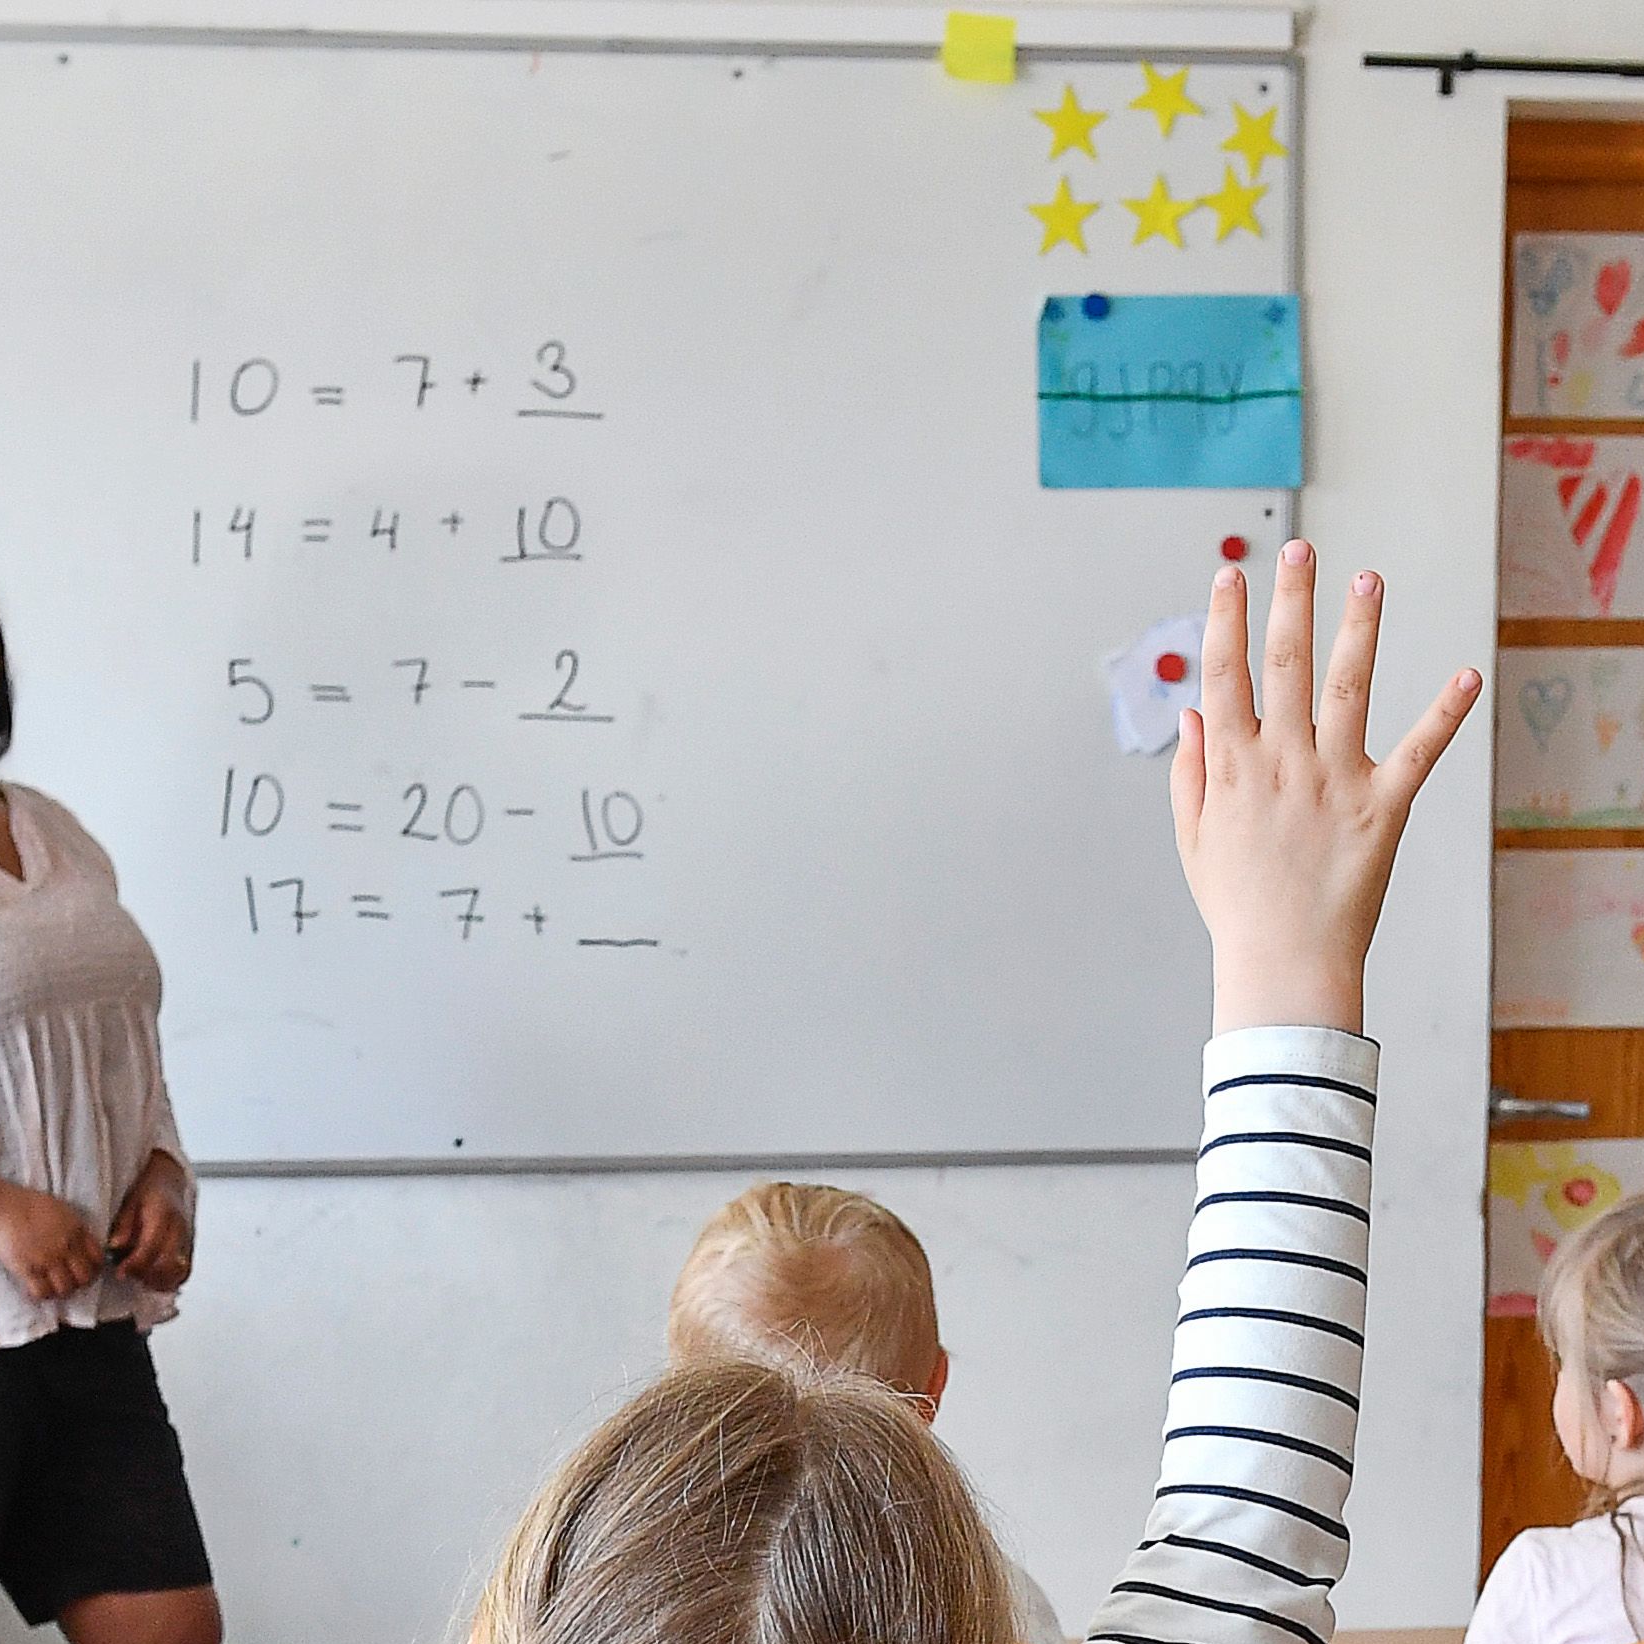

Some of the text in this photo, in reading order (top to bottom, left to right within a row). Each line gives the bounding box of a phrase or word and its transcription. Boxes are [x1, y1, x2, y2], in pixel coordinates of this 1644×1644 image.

[191, 357, 280, 423] 10
[394, 354, 437, 409] 7
[531, 339, 577, 401] 3
[191, 504, 257, 566] 14
[369, 509, 401, 552] 4
[515, 496, 582, 559] 10
[227, 656, 276, 726] 5
[393, 657, 432, 706] 7
[548, 648, 588, 713] 2
[220, 766, 286, 838] 10
[399, 781, 485, 846] 20
[580, 788, 645, 852] 10
[244, 875, 321, 936] 17
[438, 886, 485, 941] 7
